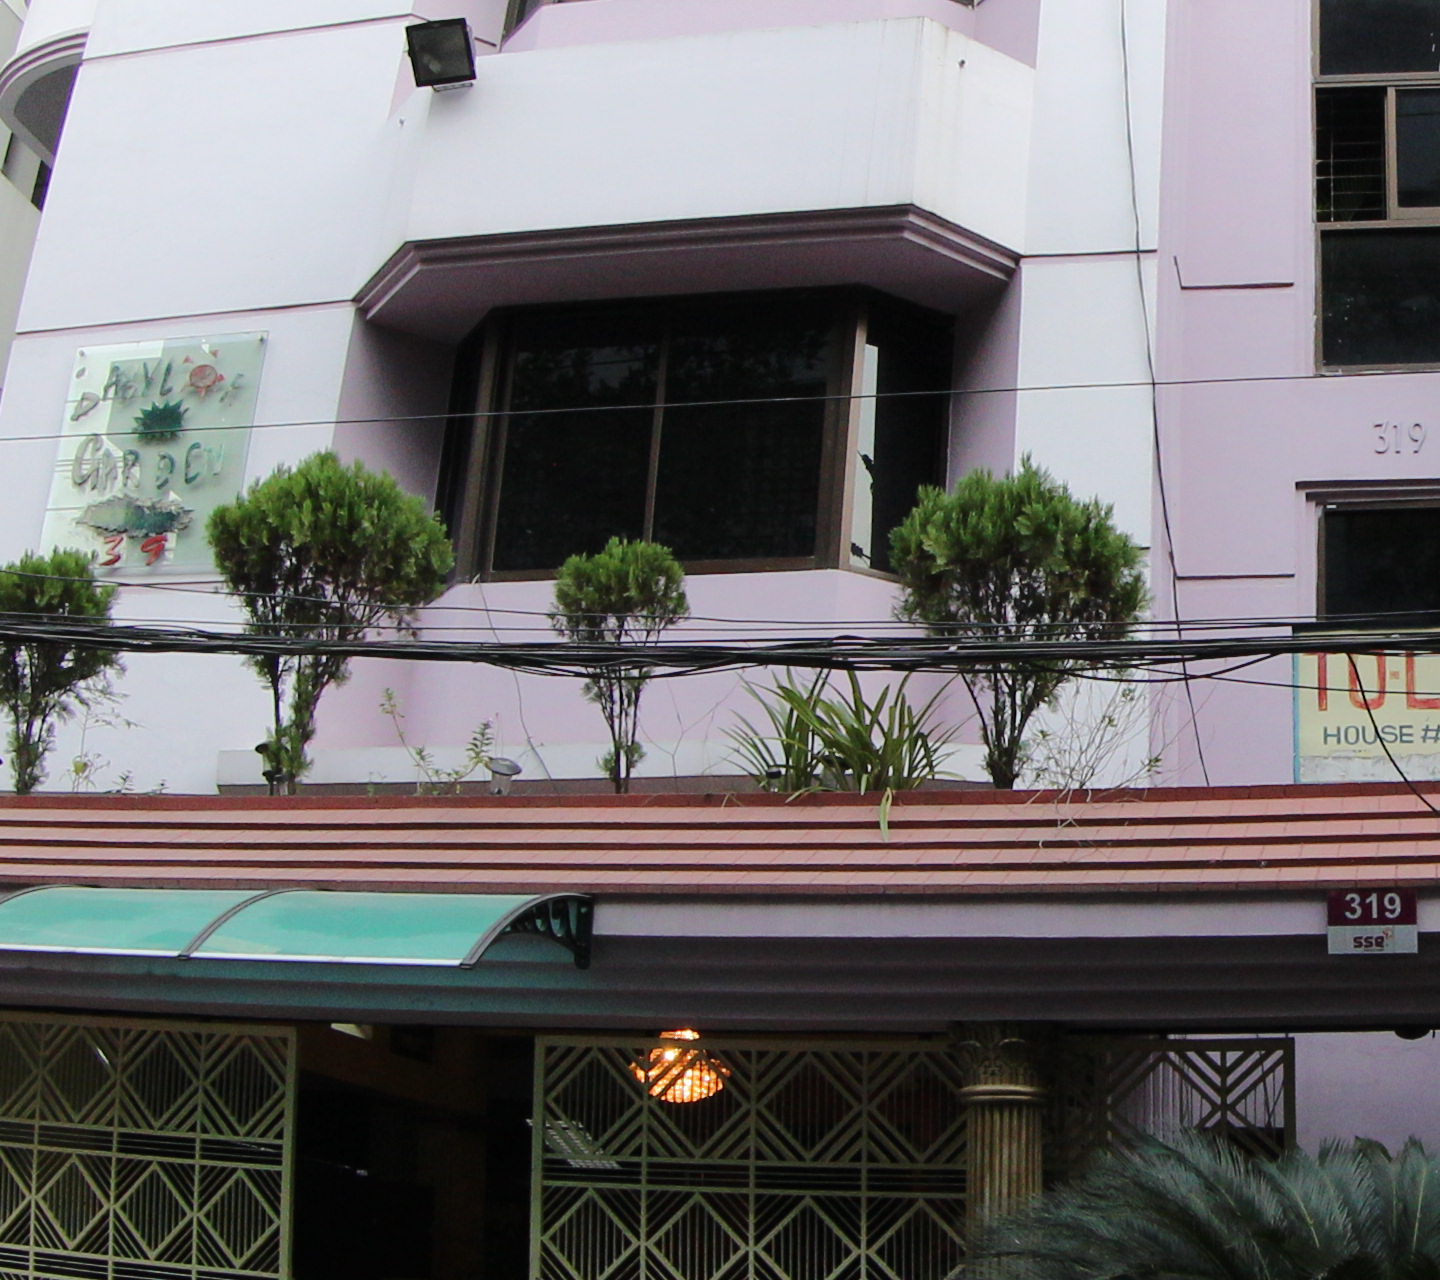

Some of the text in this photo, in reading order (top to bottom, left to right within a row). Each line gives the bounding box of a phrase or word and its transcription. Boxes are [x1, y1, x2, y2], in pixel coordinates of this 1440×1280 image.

[1372, 420, 1428, 455] 319
[1323, 725, 1414, 745] HOUSE
[1344, 892, 1401, 919] 319
